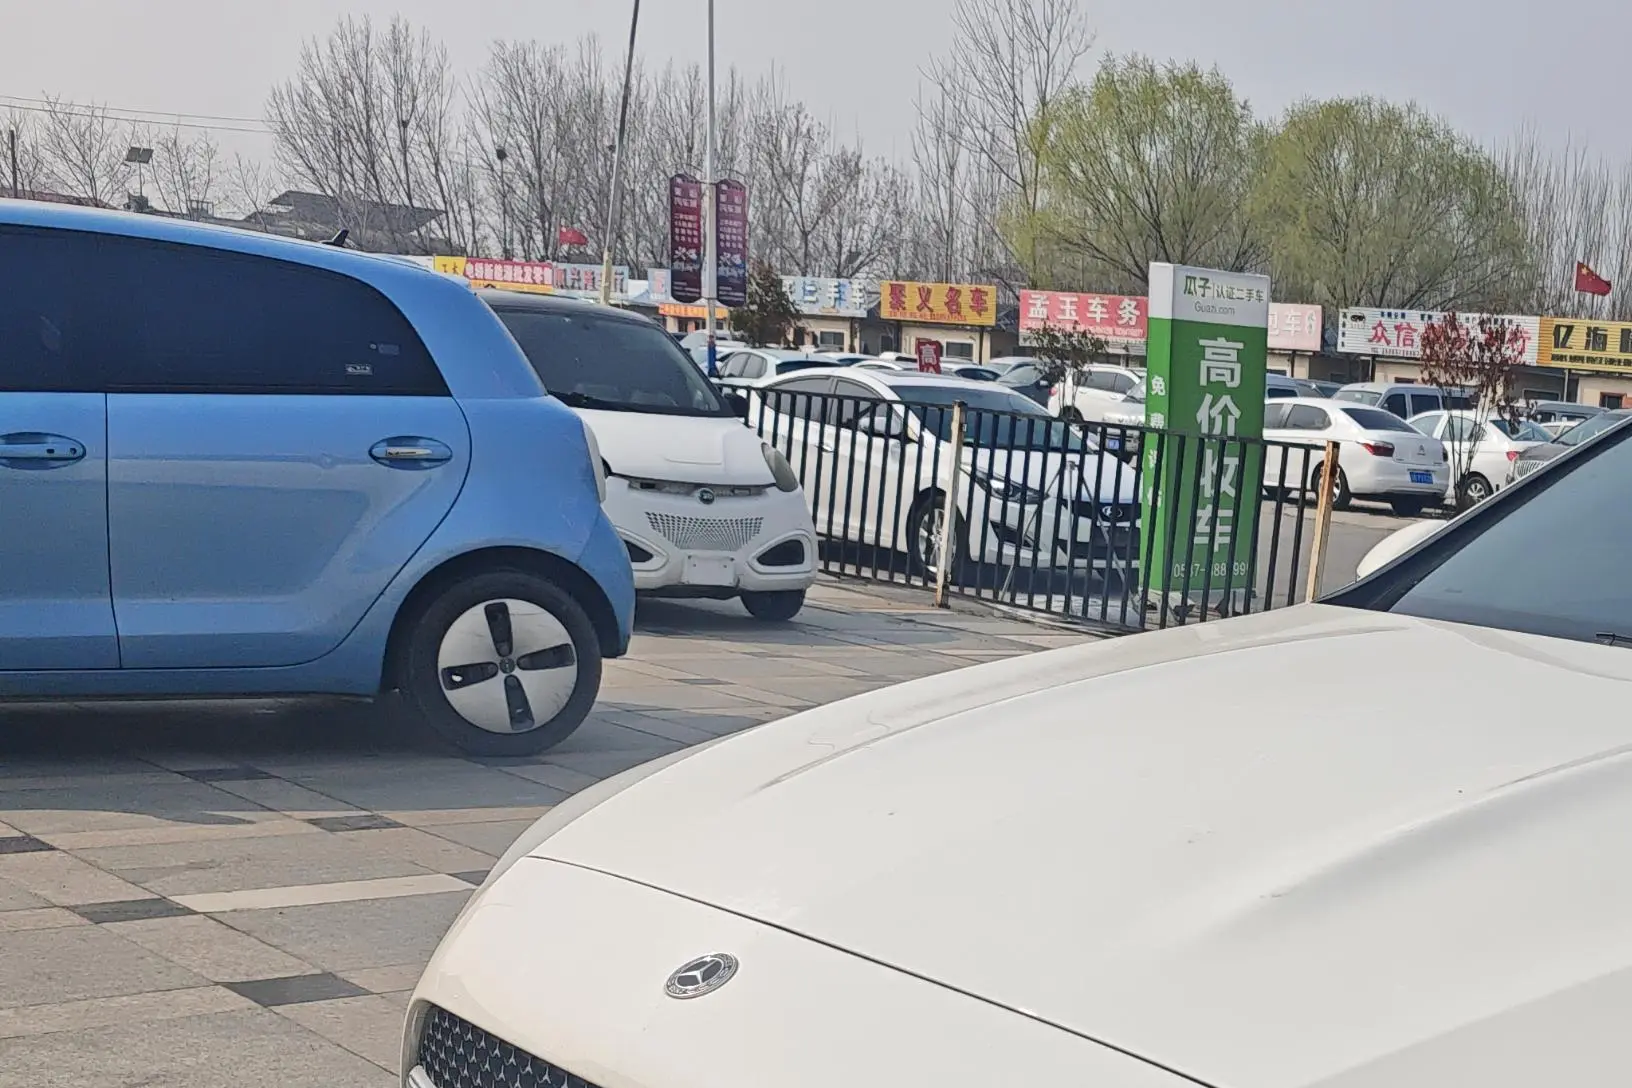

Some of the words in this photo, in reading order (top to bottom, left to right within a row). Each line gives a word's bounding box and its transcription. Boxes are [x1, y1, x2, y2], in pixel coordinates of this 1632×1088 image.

[888, 283, 989, 317] 聚义名车
[1183, 275, 1211, 298] 瓜子
[1216, 285, 1264, 303] 认证二手车
[1028, 294, 1141, 327] 孟玉车务
[1194, 301, 1235, 316] Guazi.com
[1194, 336, 1242, 552] 高价收车
